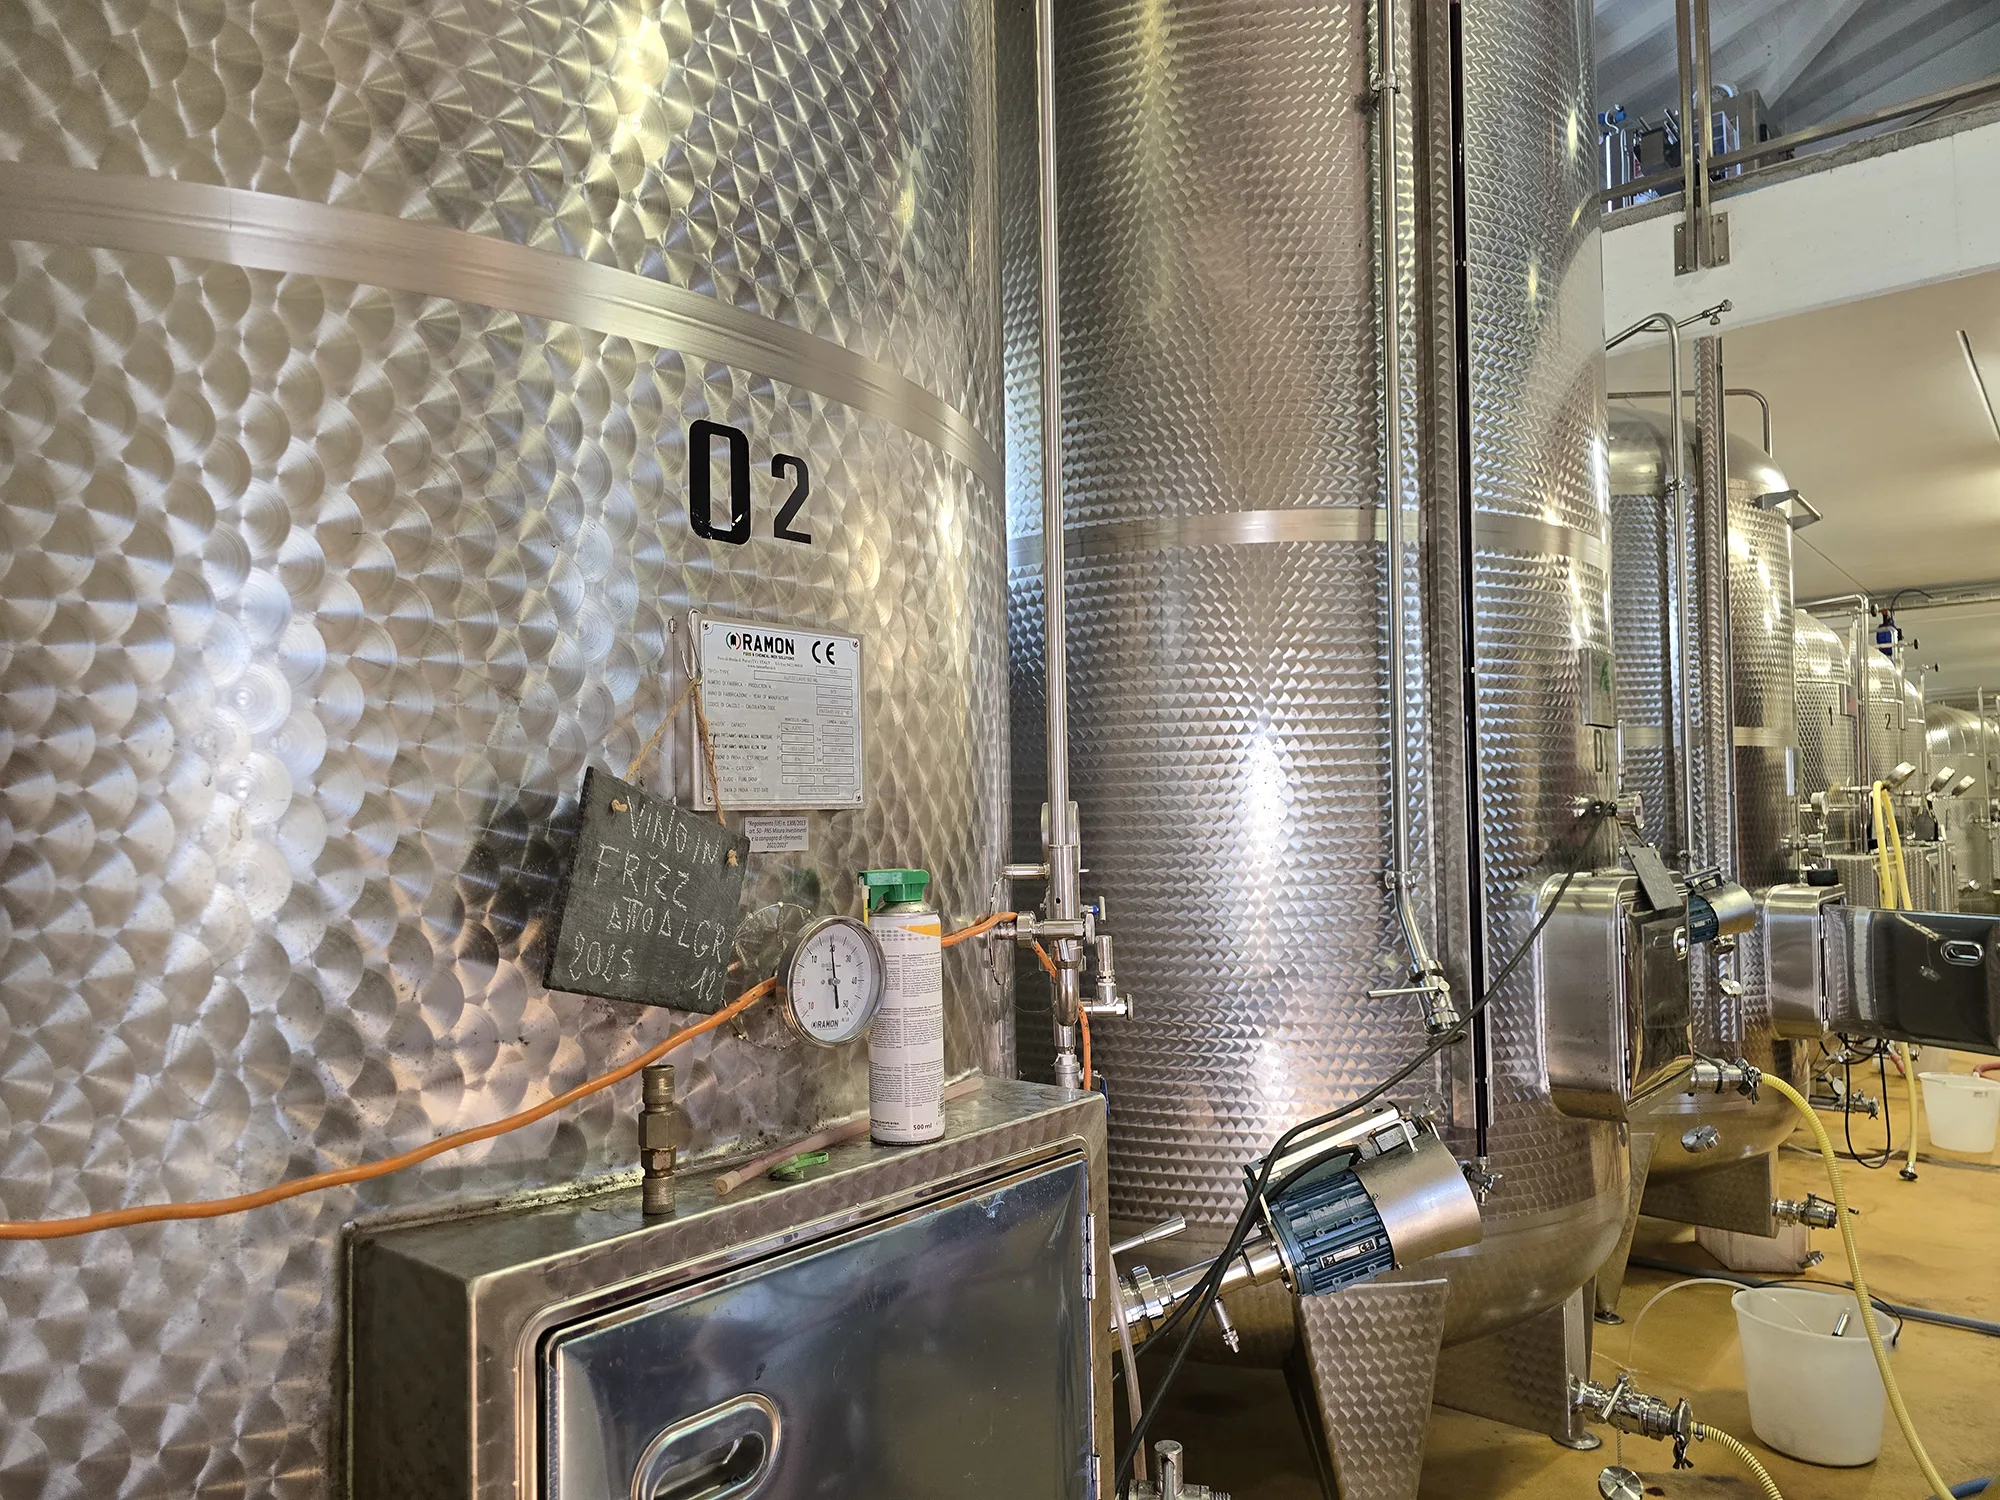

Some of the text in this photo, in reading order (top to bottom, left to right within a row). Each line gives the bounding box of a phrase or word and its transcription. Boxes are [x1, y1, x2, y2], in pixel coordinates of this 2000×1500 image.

[743, 634, 794, 655] RAMON
[1885, 713, 1891, 730] 2
[626, 796, 688, 853] VINO
[811, 955, 817, 963] 10
[851, 976, 857, 984] 40
[817, 1020, 839, 1028] RAMON
